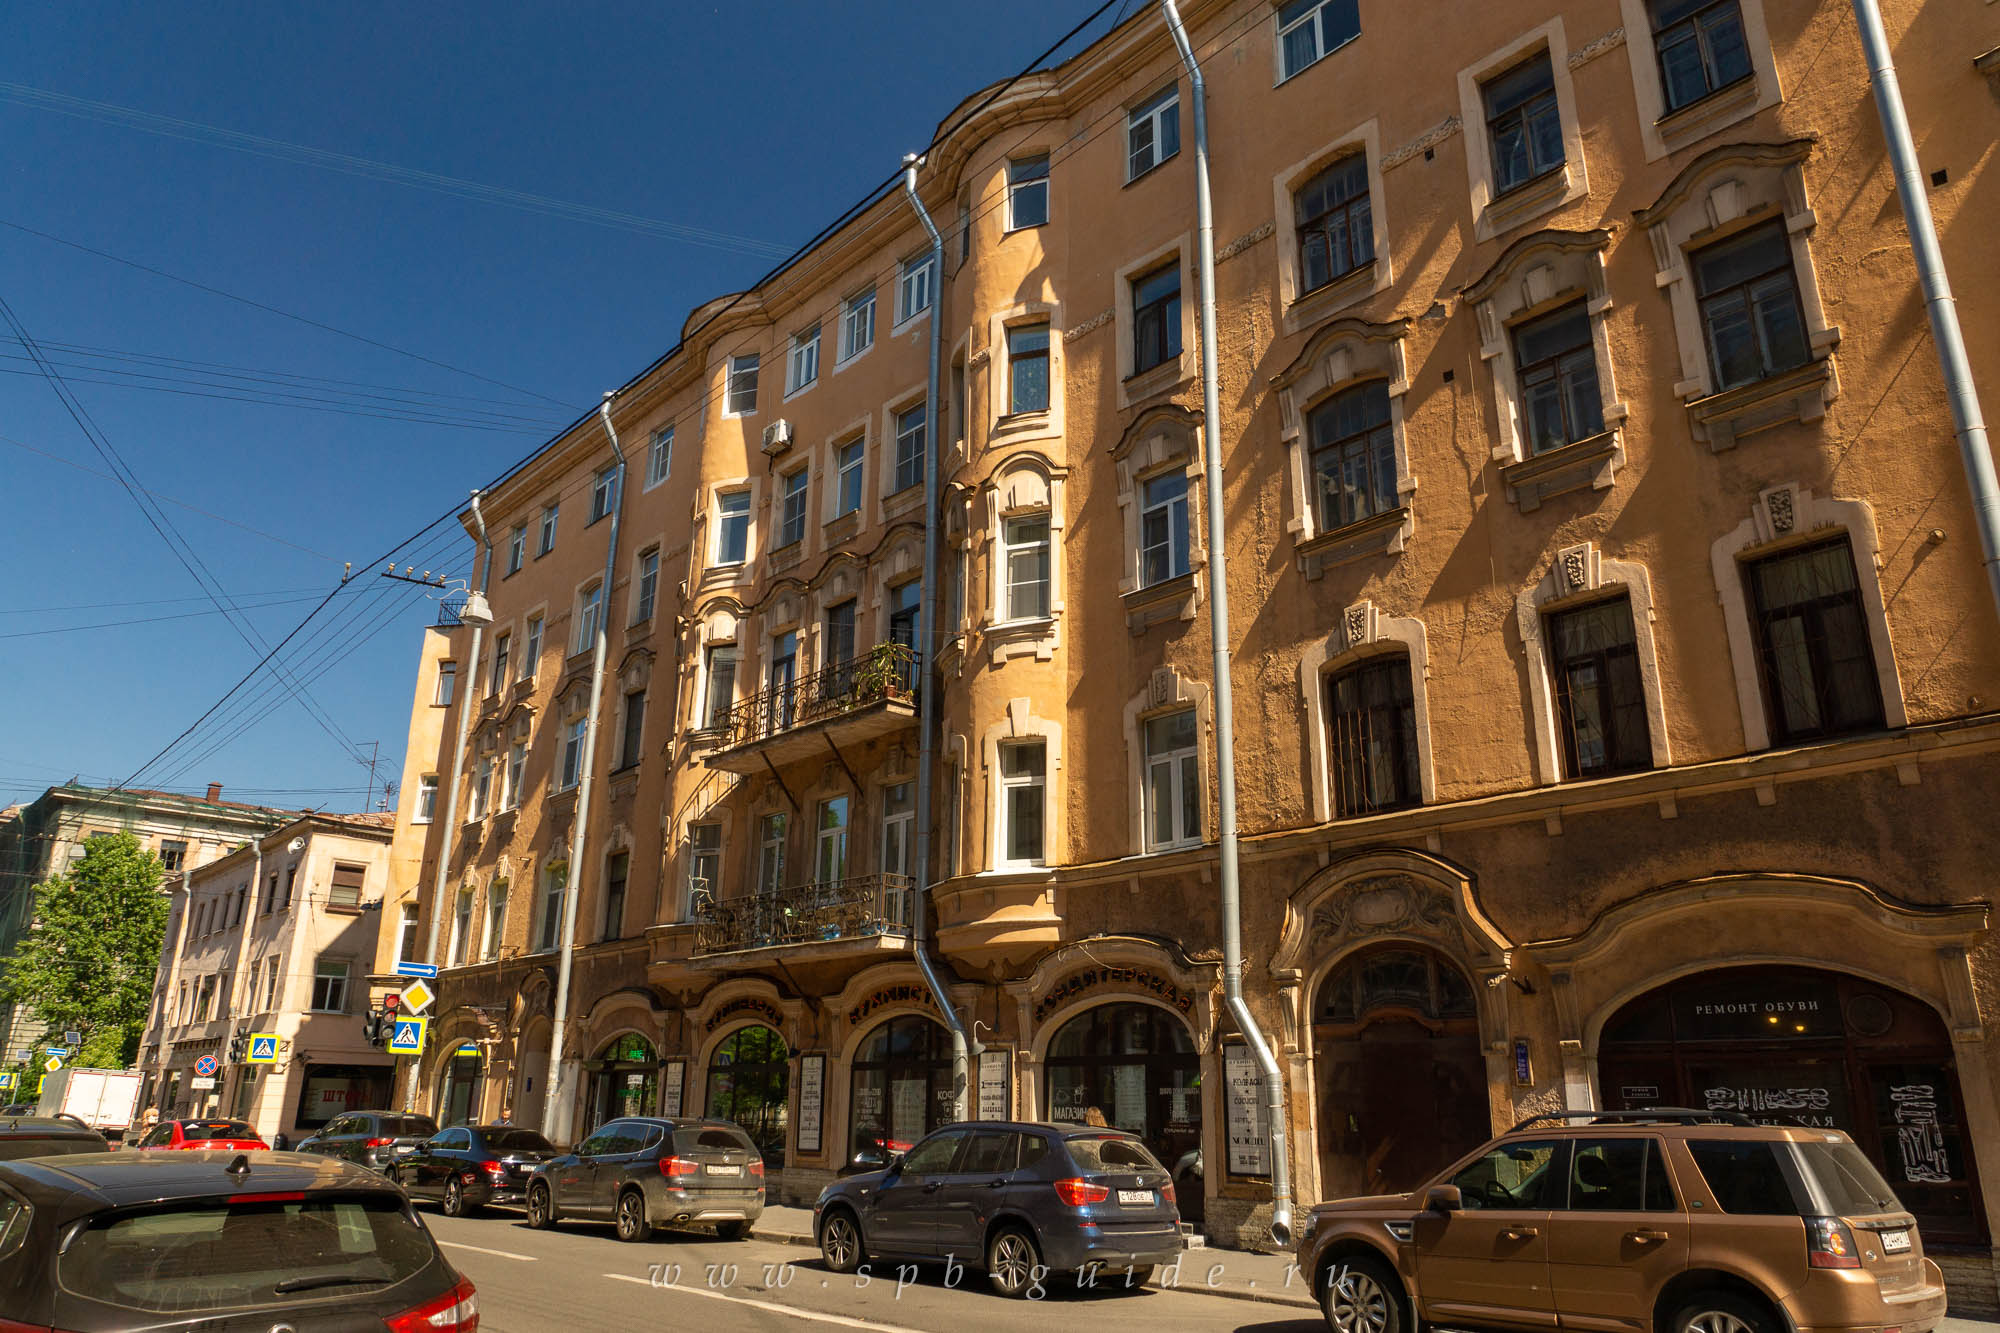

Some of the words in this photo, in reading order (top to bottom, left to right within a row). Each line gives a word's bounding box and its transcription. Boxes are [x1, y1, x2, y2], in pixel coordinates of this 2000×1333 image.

[1032, 967, 1193, 1021] КОНДИТЕРСКАЯ
[1695, 1002, 1758, 1015] РЕМОНТ
[1764, 1000, 1819, 1013] ОБУВИ
[1054, 1106, 1088, 1120] МАГАЗИН
